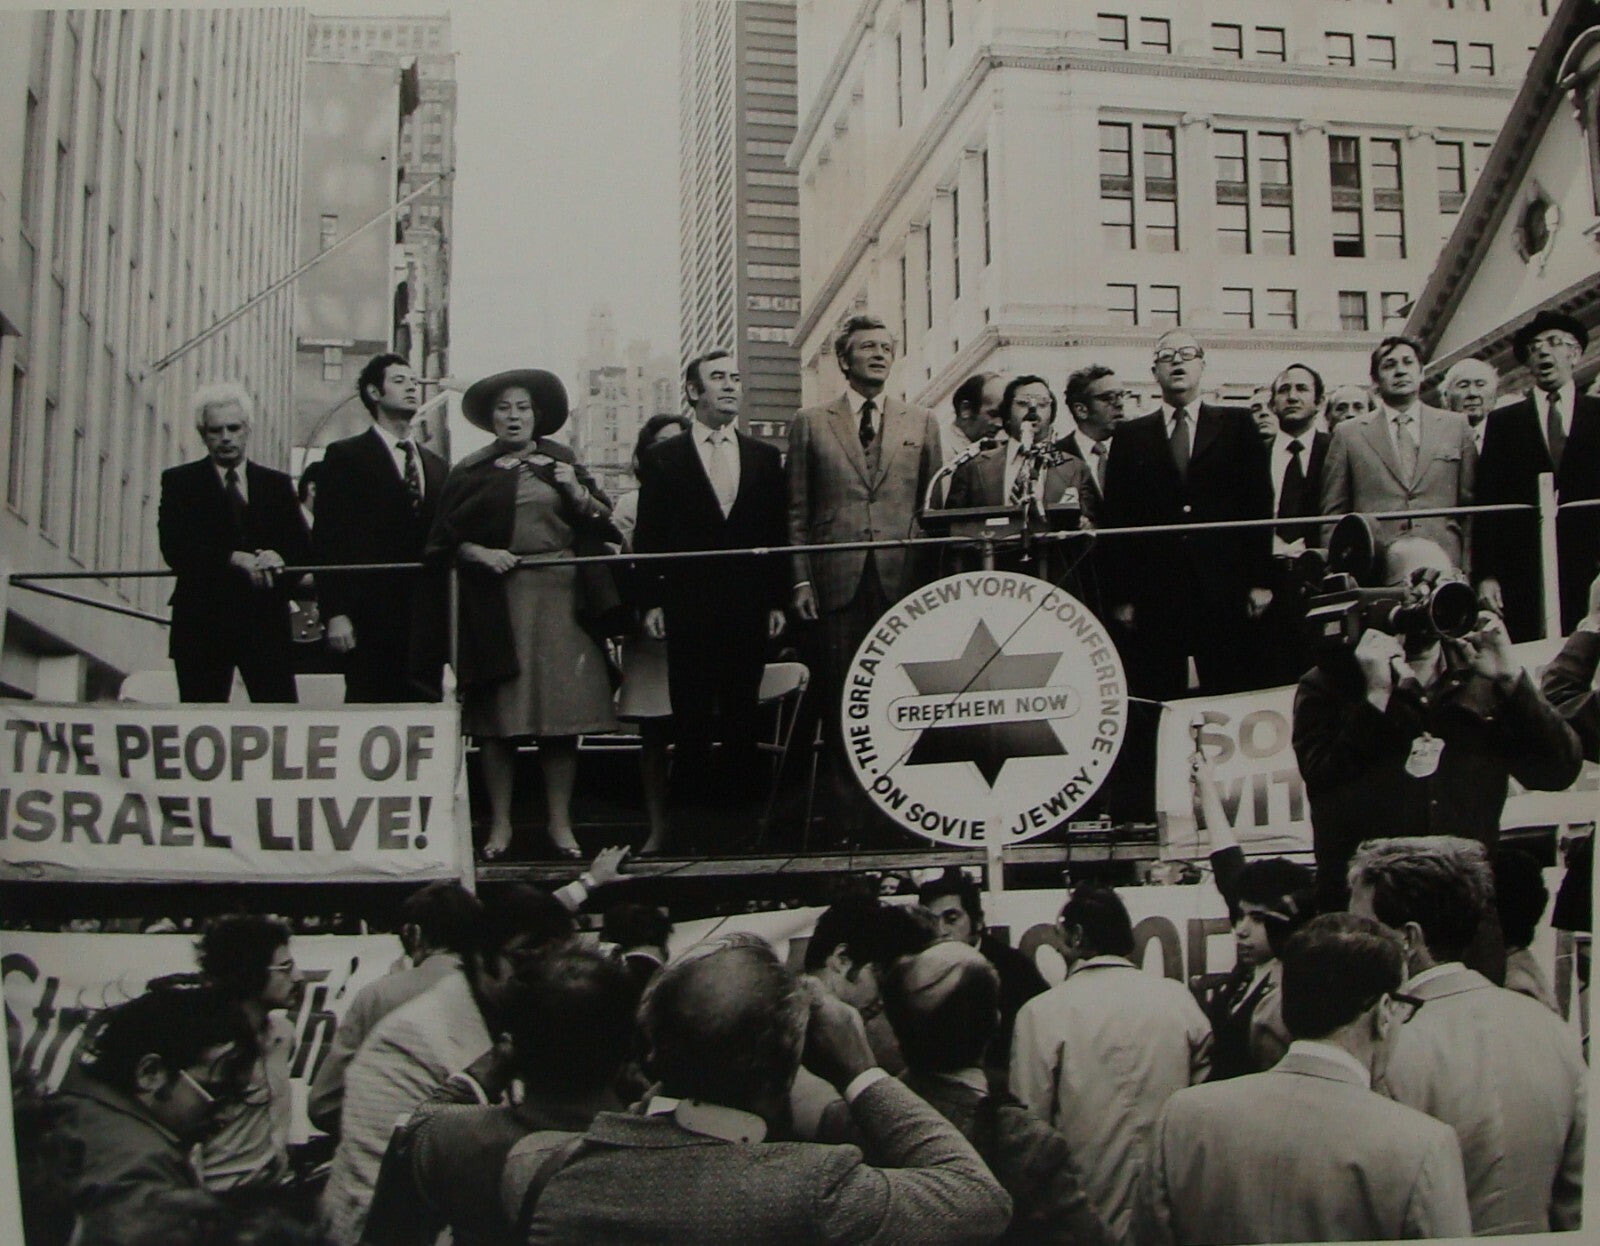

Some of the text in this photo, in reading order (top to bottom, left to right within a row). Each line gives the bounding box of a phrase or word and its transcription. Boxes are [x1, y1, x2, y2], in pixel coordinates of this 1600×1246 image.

[849, 577, 1120, 770] THE GREATER NEW YORK CONFERENCE
[1016, 694, 1069, 714] NOW
[5, 719, 435, 782] THE PEOPLE OF
[0, 788, 433, 851] ISRAEL LIVE!
[873, 767, 1094, 841] ON SOVIE JEWRY
